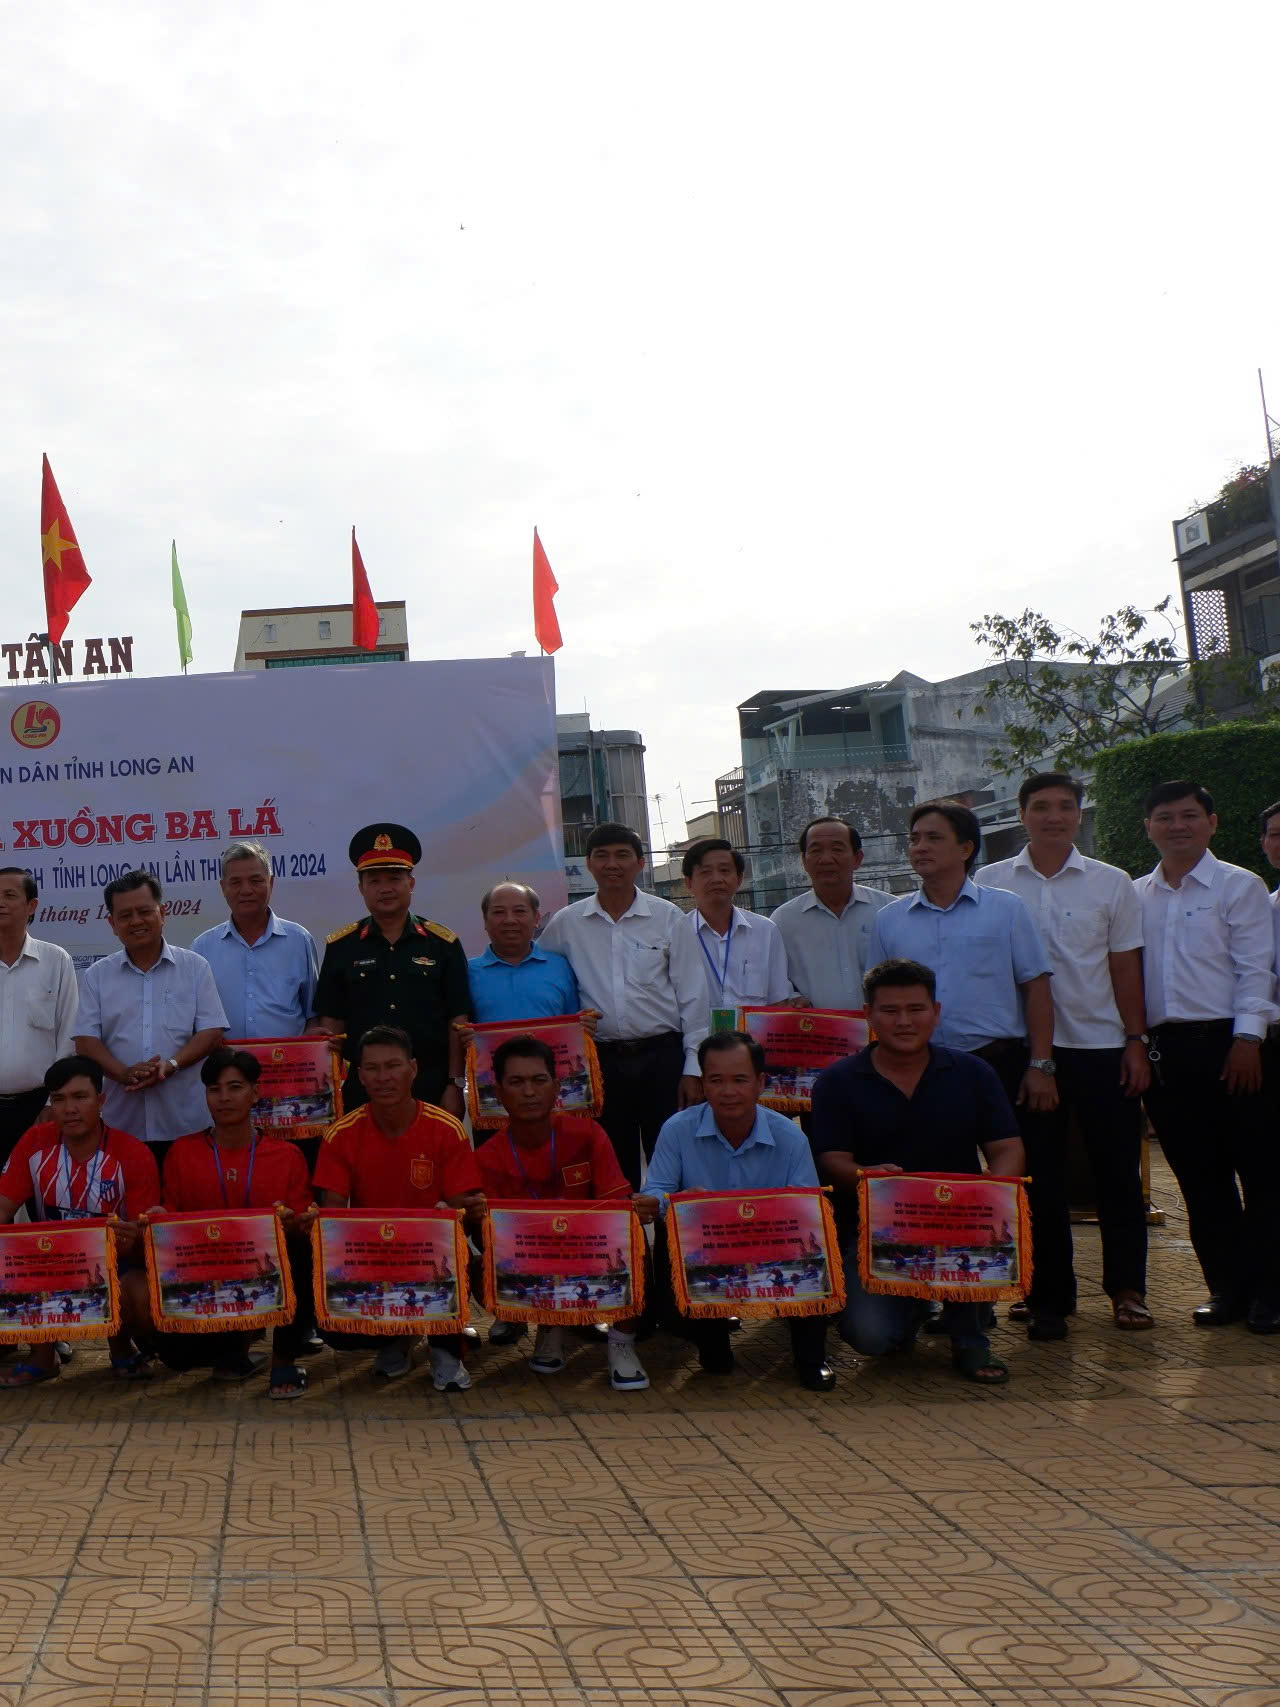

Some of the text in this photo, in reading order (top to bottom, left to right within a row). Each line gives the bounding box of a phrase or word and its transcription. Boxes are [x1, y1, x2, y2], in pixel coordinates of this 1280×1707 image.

[1, 633, 74, 680] TÂN
[82, 636, 134, 676] AN
[19, 761, 59, 783] DÂN
[64, 756, 104, 780] TỈNH
[110, 757, 161, 778] LONG
[167, 755, 195, 774] AN
[12, 806, 156, 850] XUỒNG
[165, 808, 220, 841] BA
[228, 797, 283, 837] LÁ
[52, 858, 85, 889] TỈNH
[165, 850, 196, 883] LẦN
[290, 853, 327, 877] 2024
[40, 906, 90, 925] tháng
[164, 899, 202, 916] 2024
